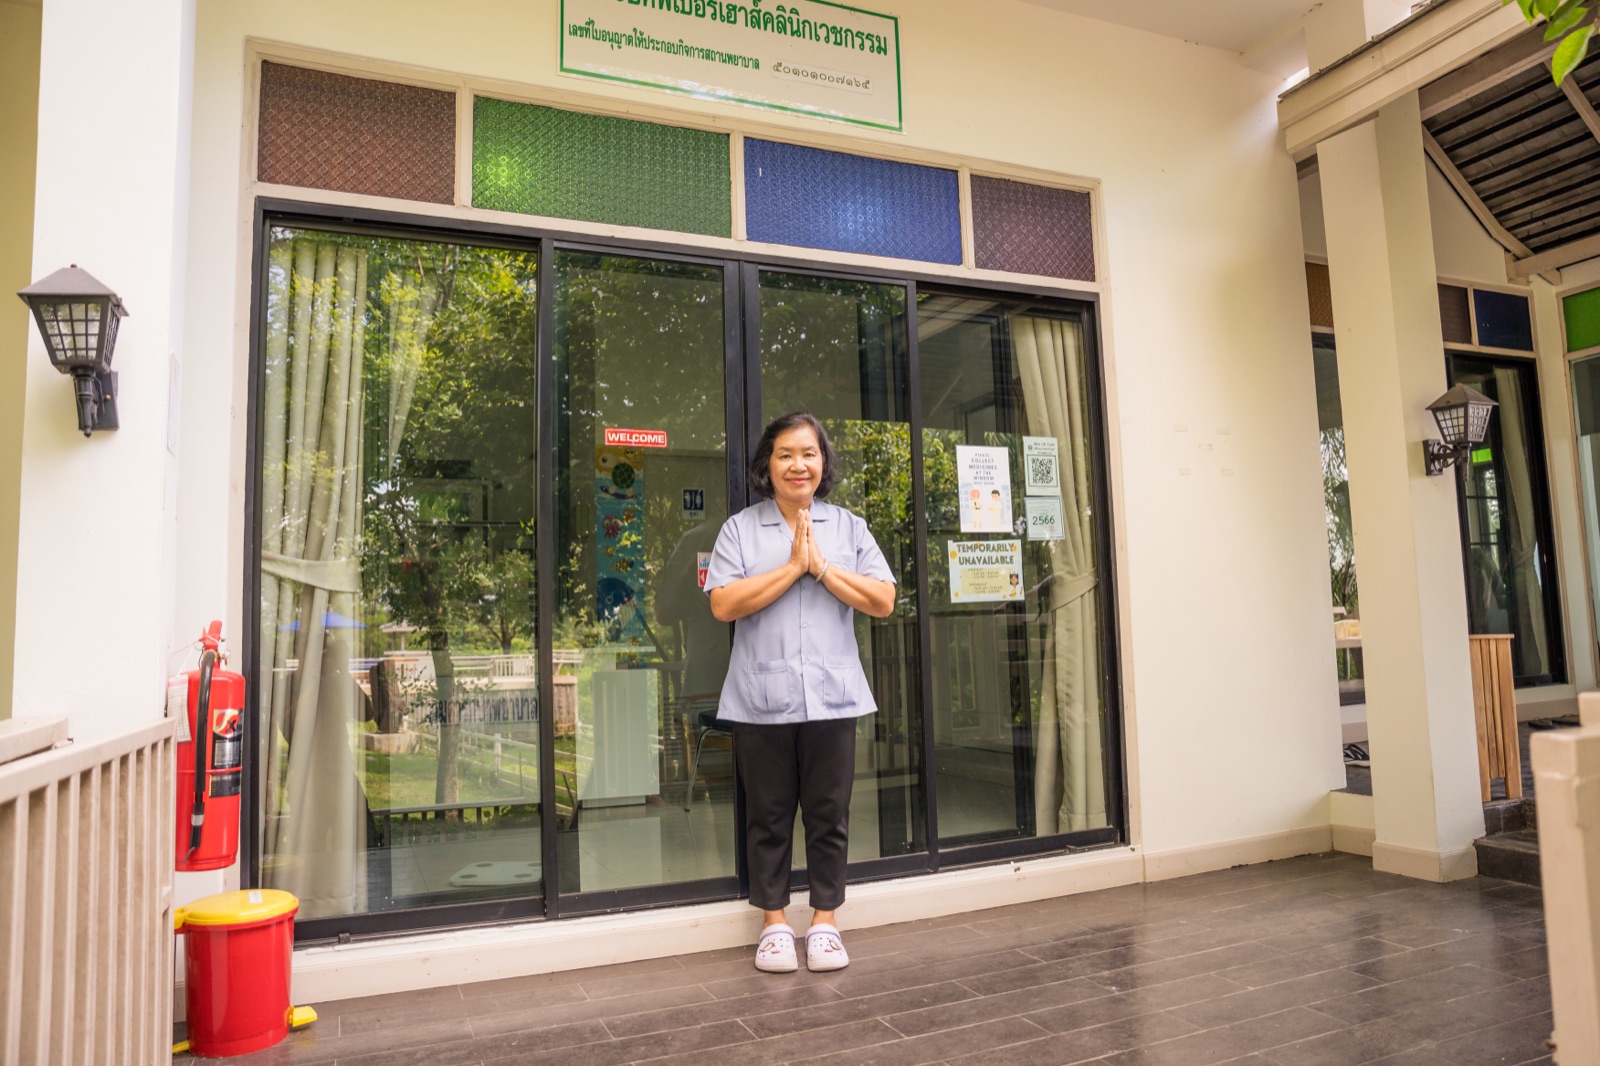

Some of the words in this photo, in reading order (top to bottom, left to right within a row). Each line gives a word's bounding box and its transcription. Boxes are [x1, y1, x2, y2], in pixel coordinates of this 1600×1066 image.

[607, 432, 665, 443] WELCOME
[1032, 514, 1056, 525] 2566
[956, 543, 1015, 553] TEMPORARILY
[958, 556, 1014, 565] UNAVAILABLE
